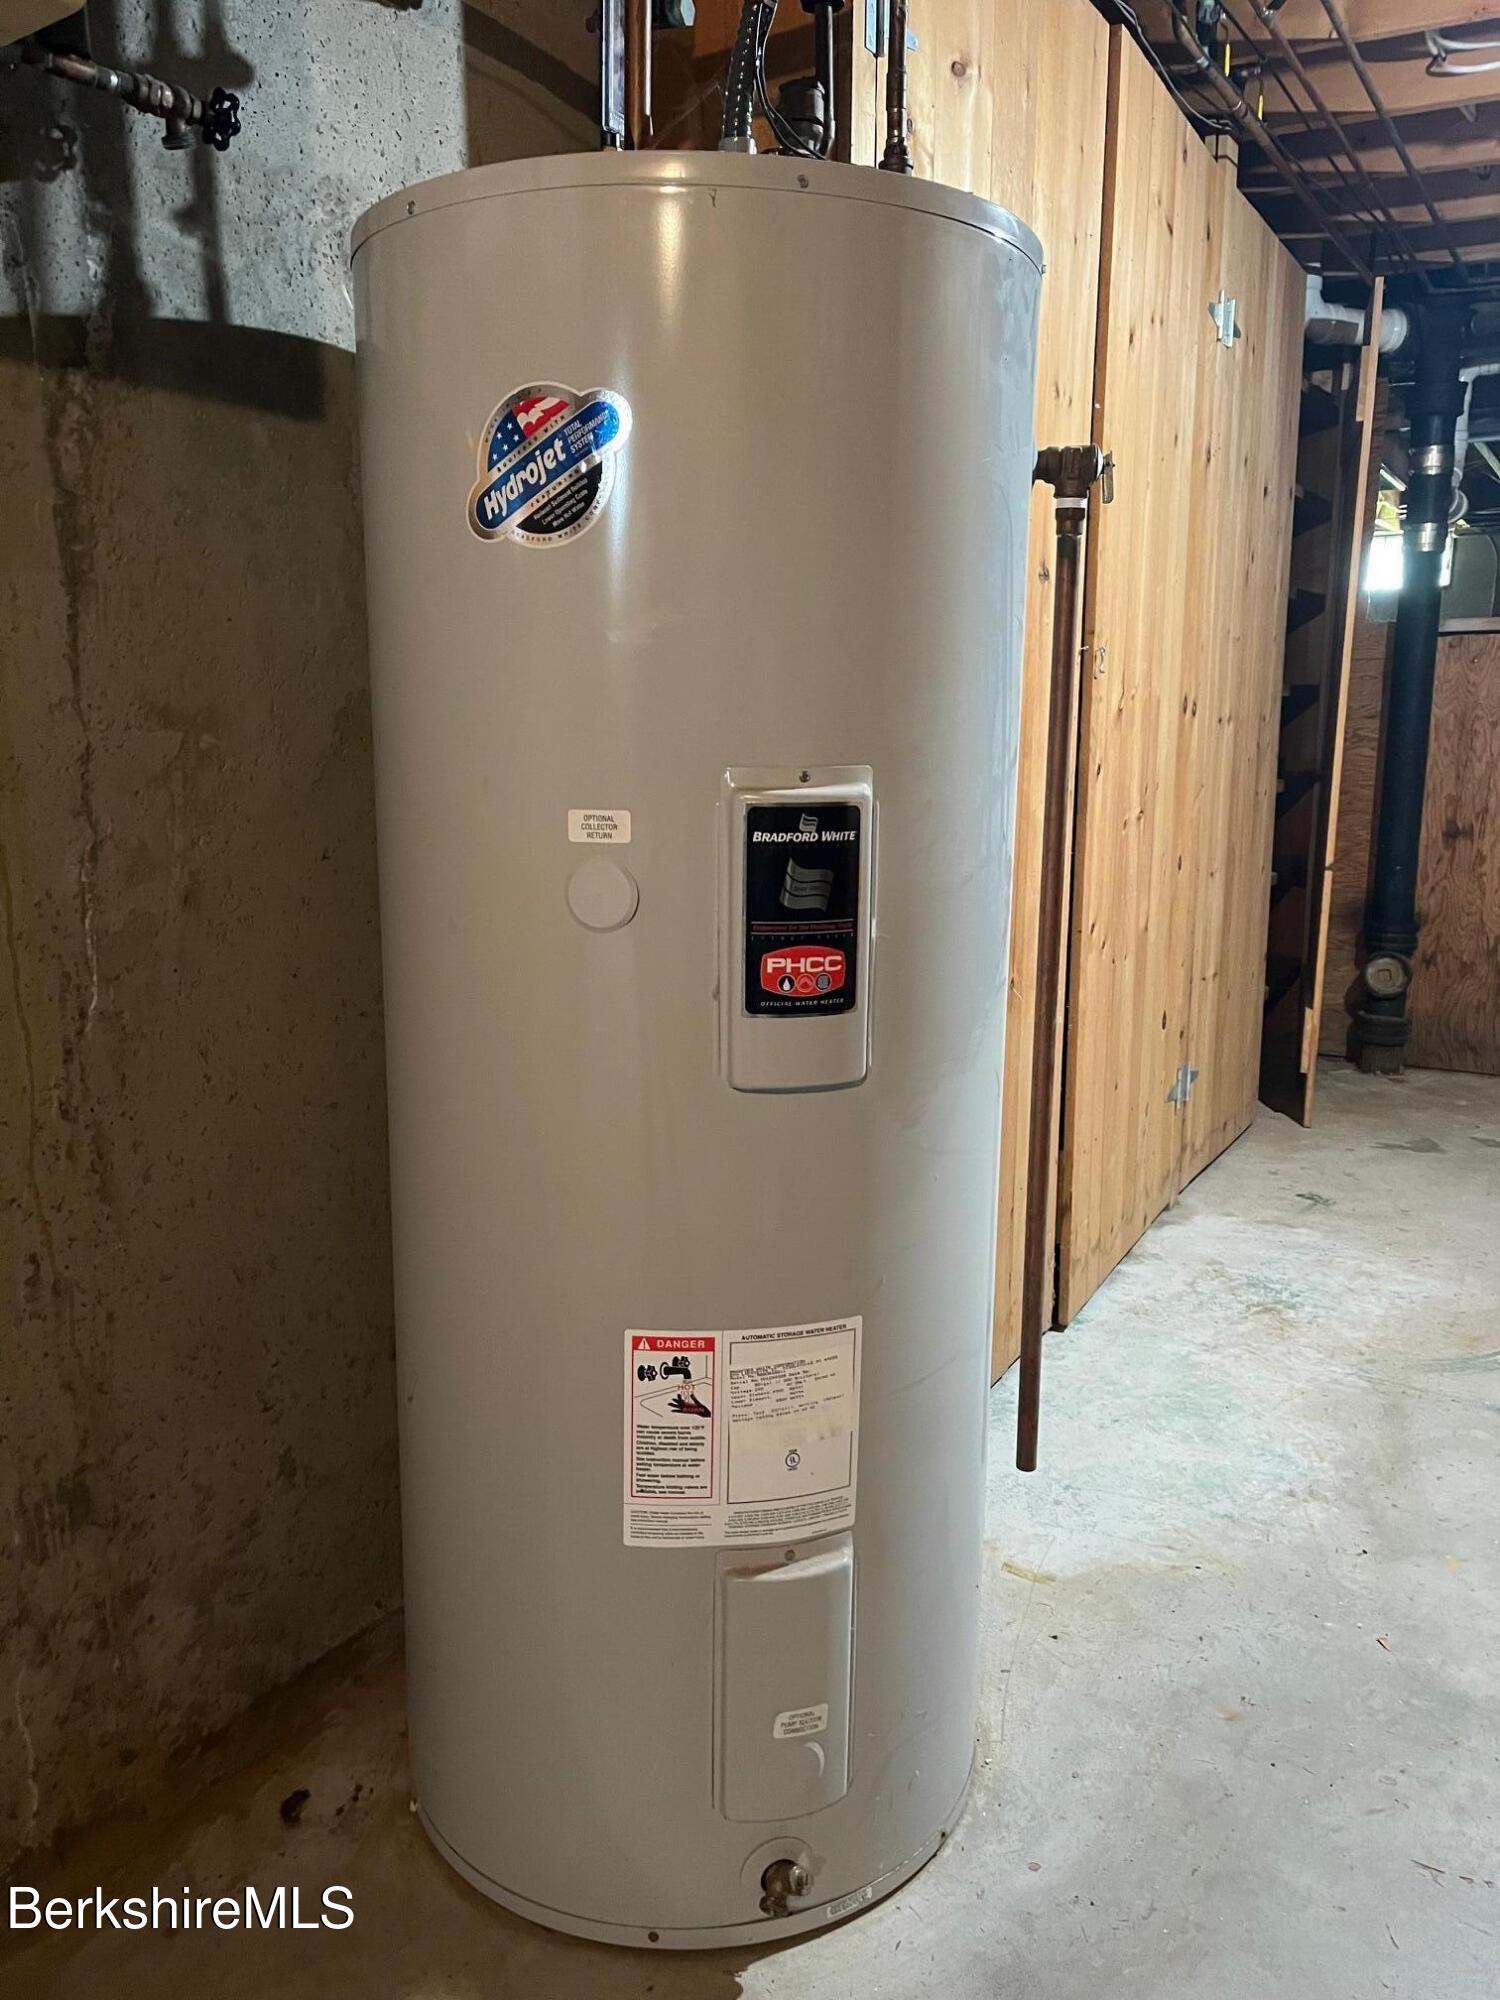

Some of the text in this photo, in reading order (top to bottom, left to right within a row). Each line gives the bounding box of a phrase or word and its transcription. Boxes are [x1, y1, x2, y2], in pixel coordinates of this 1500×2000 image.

[563, 420, 581, 437] TOTAL
[483, 437, 567, 520] Hydrojet
[583, 814, 615, 823] OPTIONAL
[580, 822, 618, 831] COLLECTOR
[586, 831, 613, 840] RETURN
[752, 830, 857, 843] BRADFORD WHITE
[766, 955, 843, 974] PHCC
[741, 1323, 847, 1341] AUTOMATIC STORAGE WATER HEATER
[656, 1339, 705, 1349] DANGER
[677, 1383, 697, 1391] HOT
